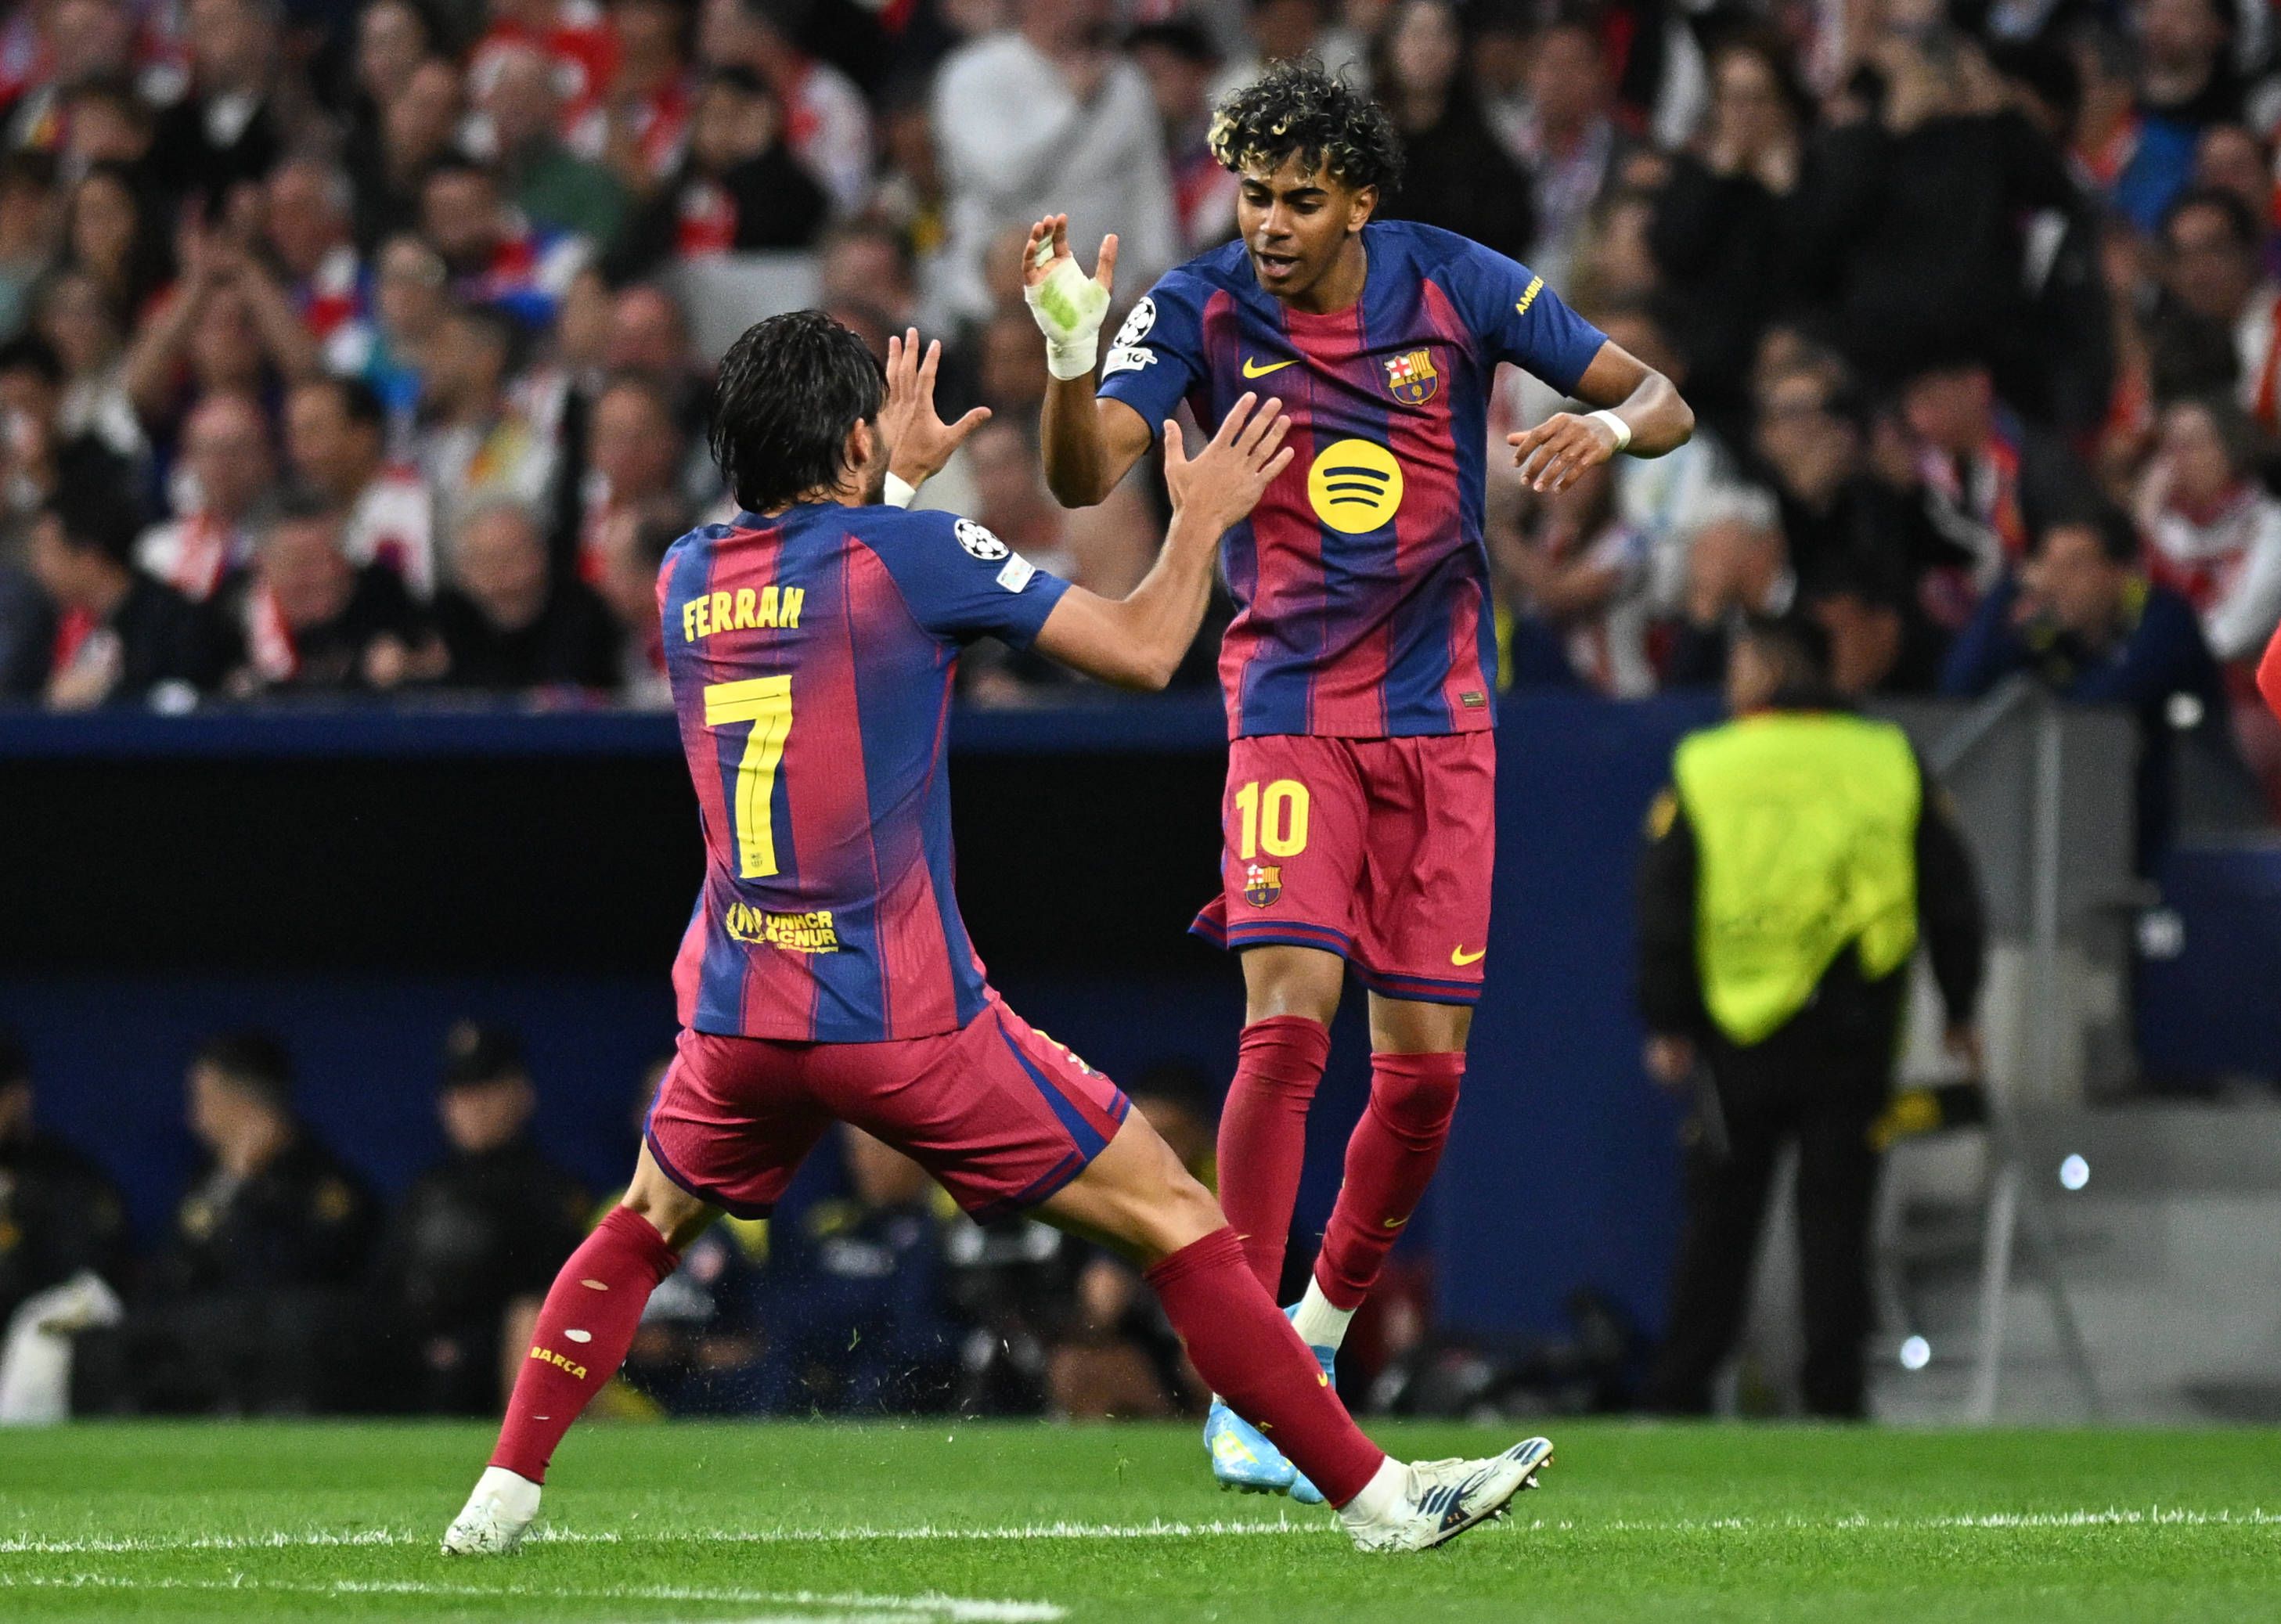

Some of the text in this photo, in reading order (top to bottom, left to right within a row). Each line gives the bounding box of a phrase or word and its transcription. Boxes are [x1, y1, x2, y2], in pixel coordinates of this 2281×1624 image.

[683, 586, 805, 643] FERRAN
[704, 675, 792, 878] 7
[1236, 780, 1310, 860] 10
[766, 911, 834, 931] UNHCR
[766, 927, 837, 946] ACNUR
